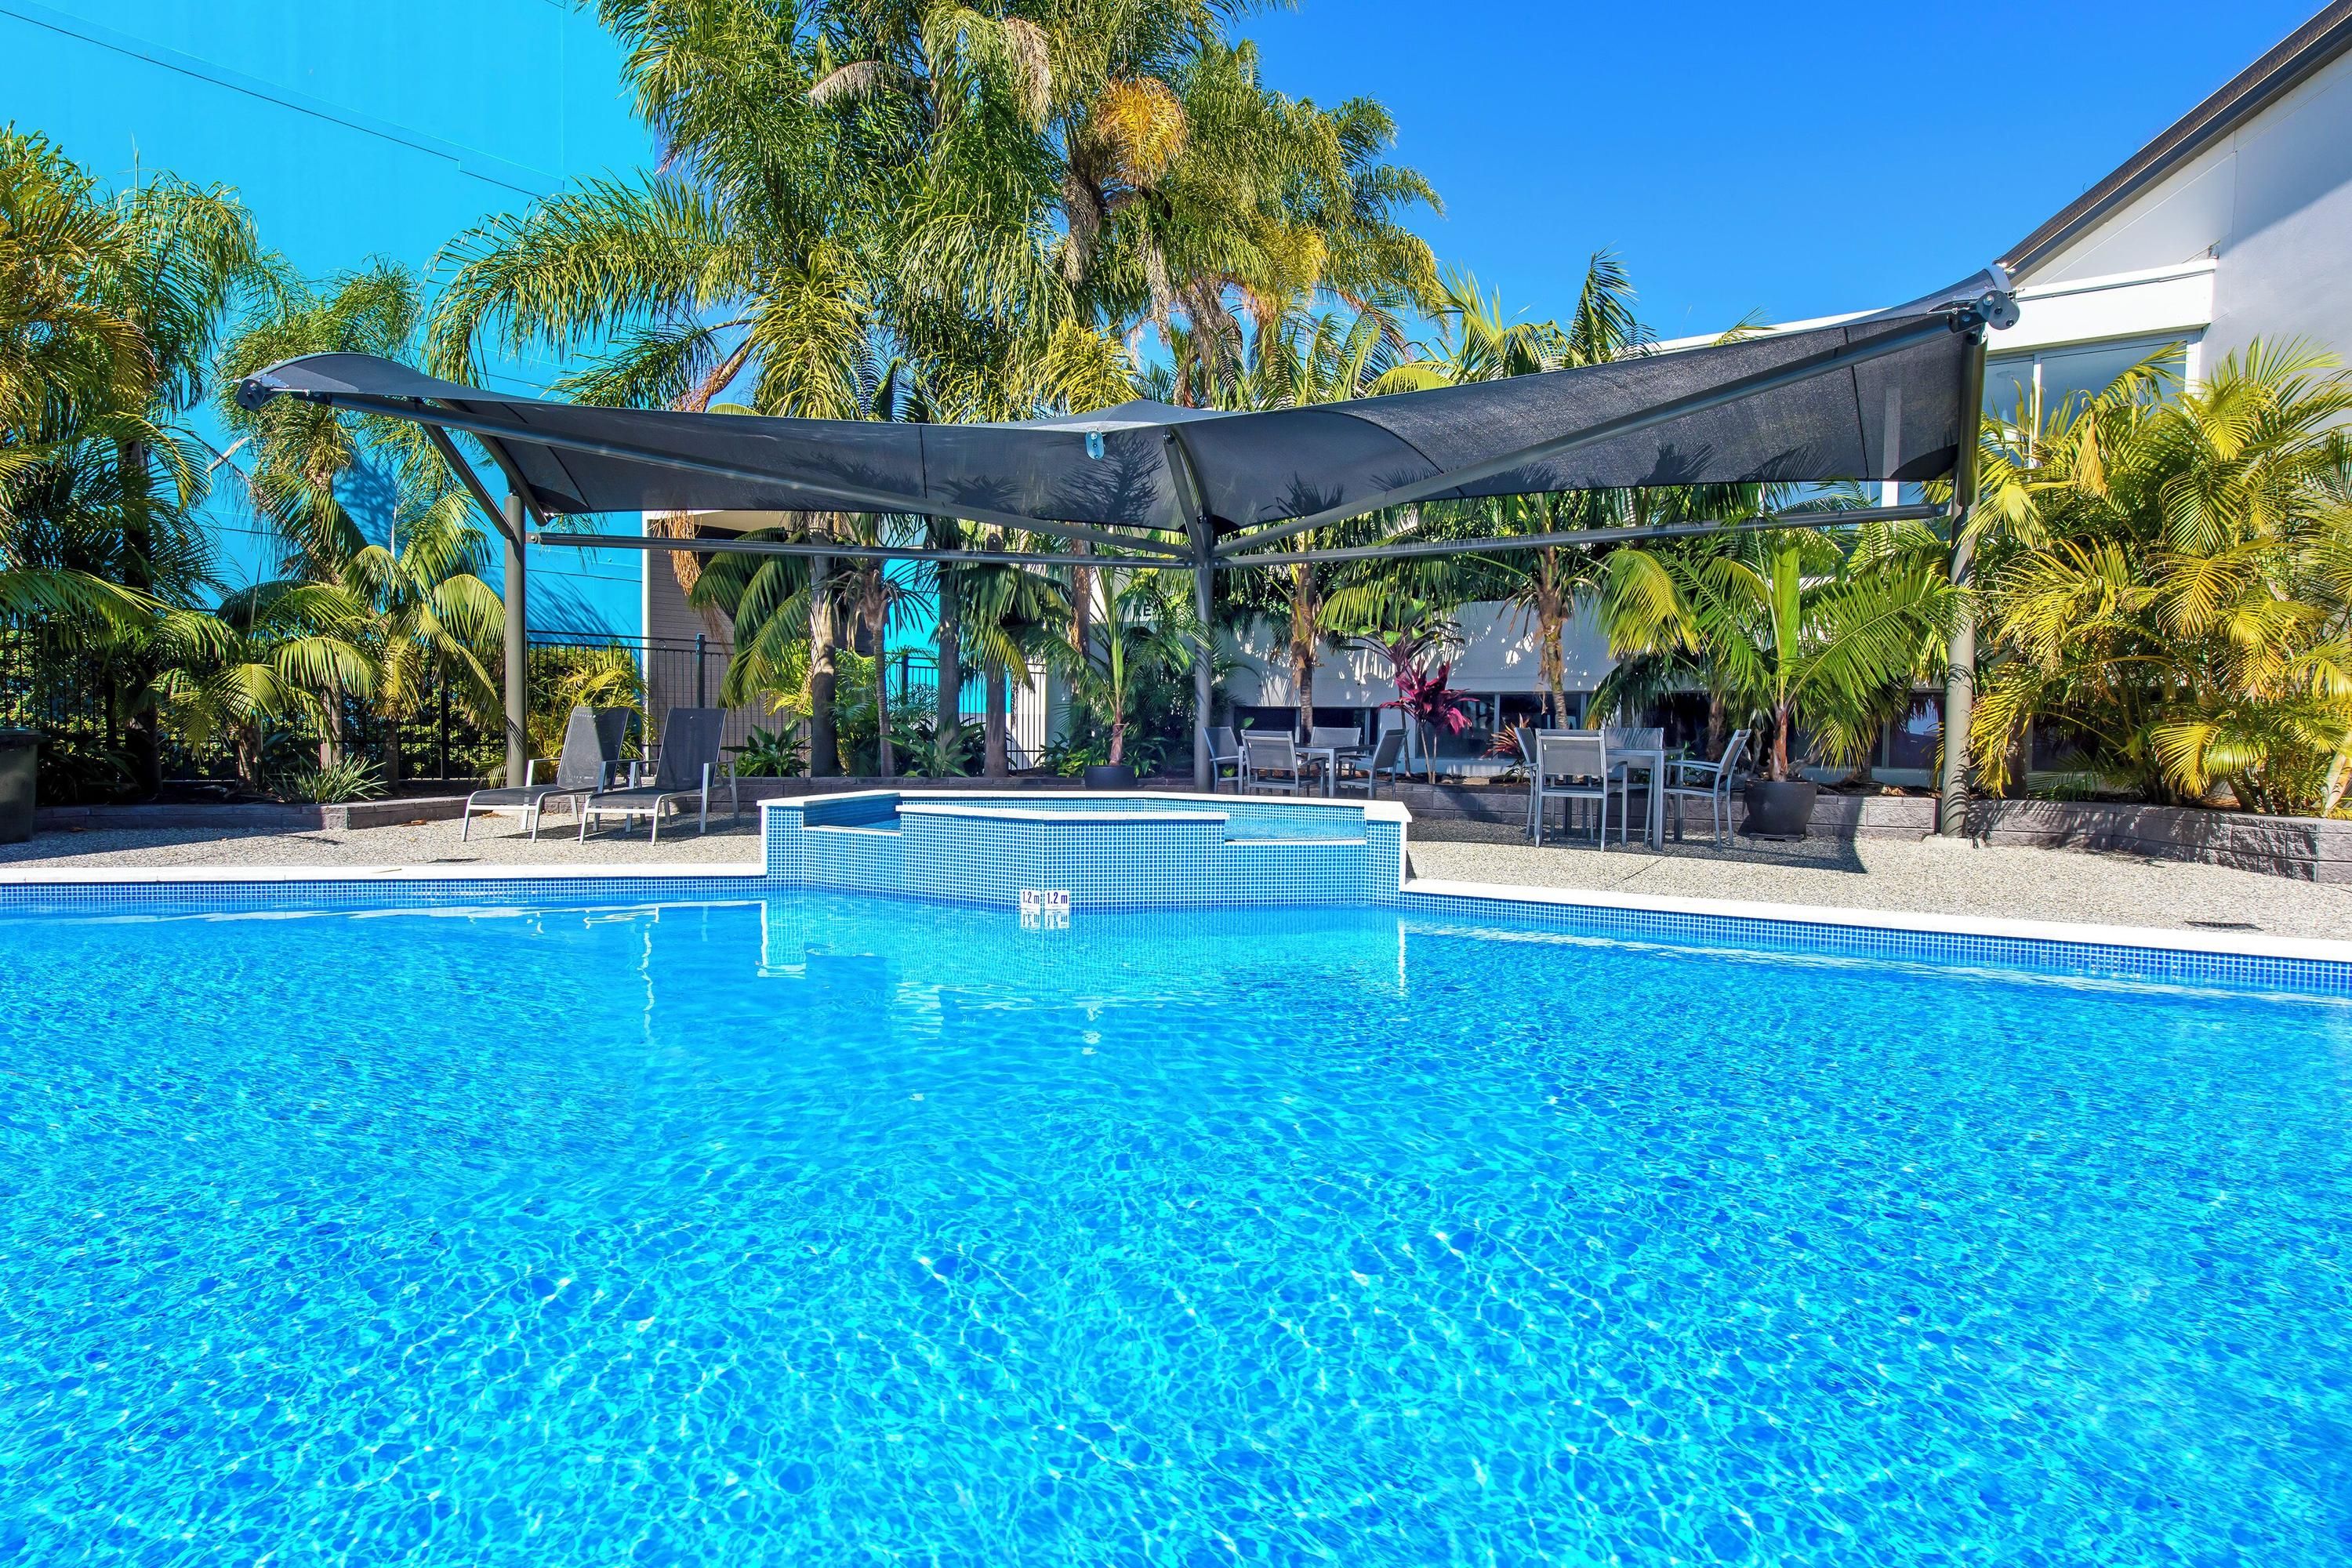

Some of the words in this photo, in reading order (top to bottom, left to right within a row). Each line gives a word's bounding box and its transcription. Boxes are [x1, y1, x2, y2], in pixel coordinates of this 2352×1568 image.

[1022, 891, 1033, 904] 1.2
[1033, 895, 1040, 905] m
[1047, 891, 1058, 905] 1.2
[1061, 895, 1068, 905] m
